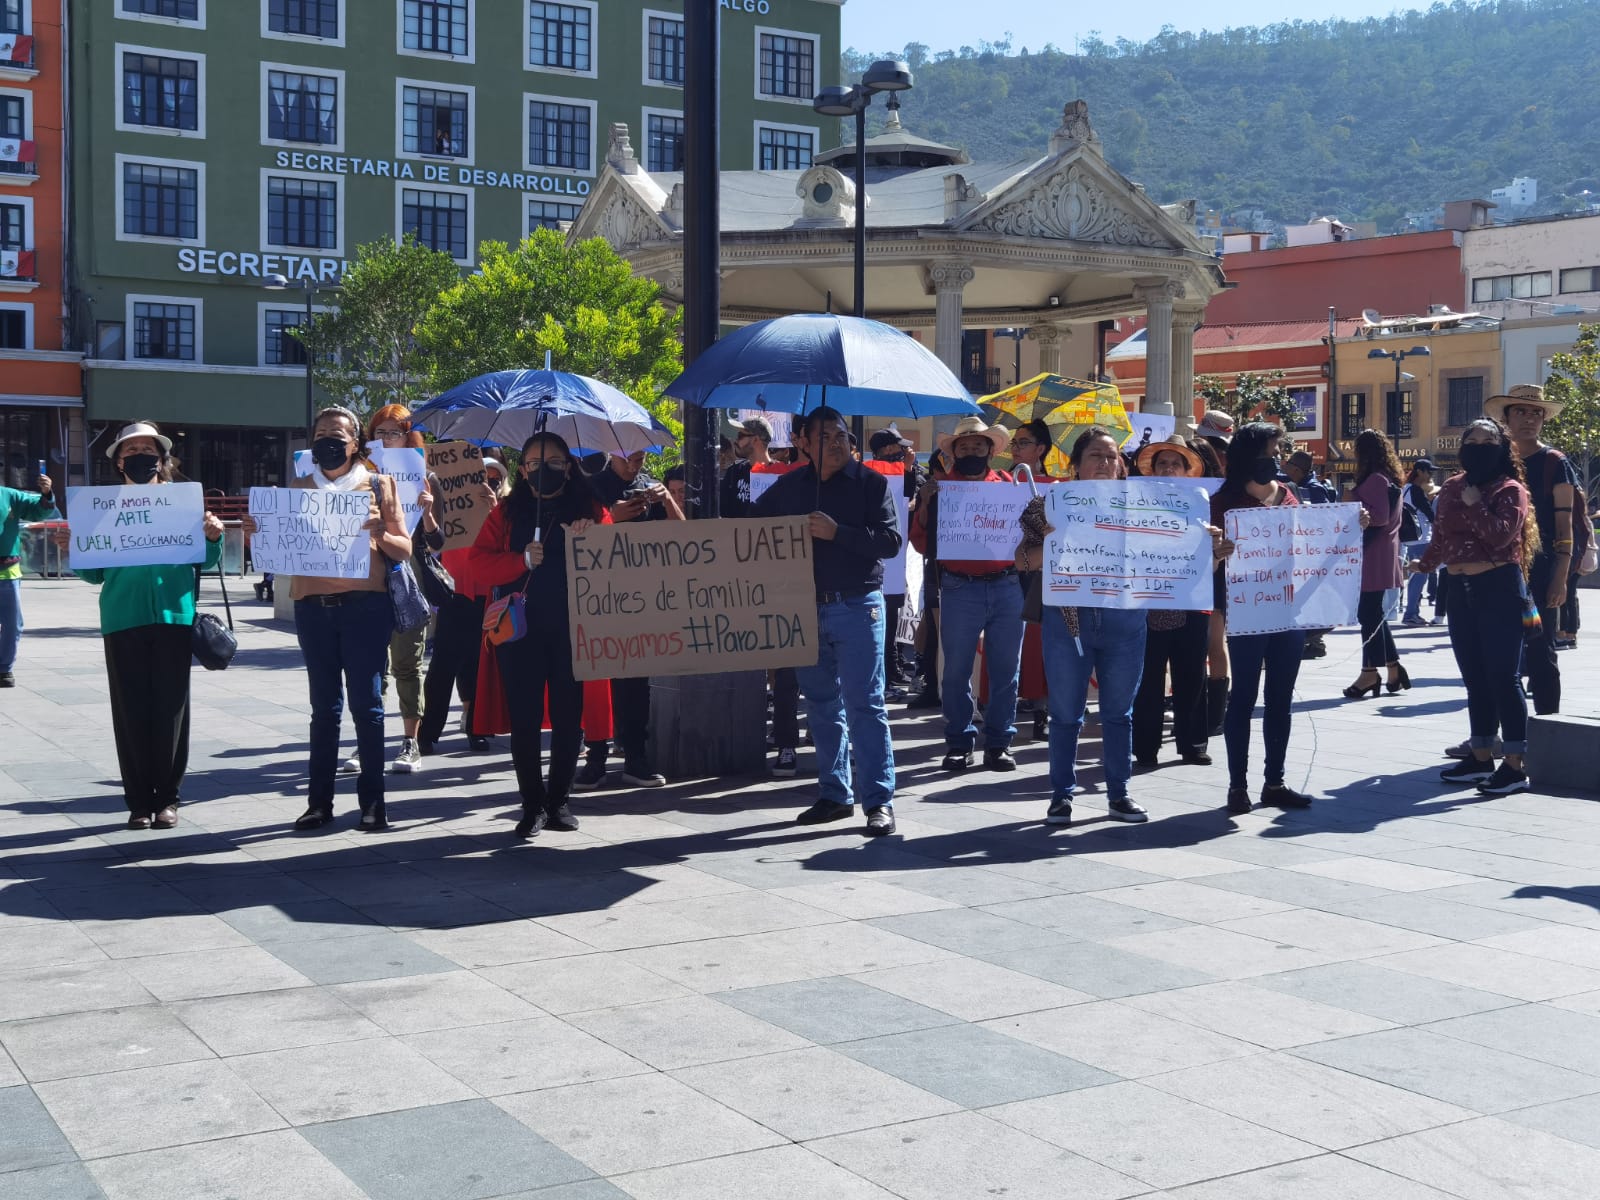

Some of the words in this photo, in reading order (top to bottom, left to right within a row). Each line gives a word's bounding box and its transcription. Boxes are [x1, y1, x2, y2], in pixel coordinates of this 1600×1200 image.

[276, 151, 414, 179] SECRETARIA
[424, 165, 450, 182] DE
[459, 168, 591, 196] DESARROLLO
[462, 444, 480, 460] de
[121, 497, 151, 509] AMOR
[155, 497, 171, 506] AL
[289, 489, 320, 515] LOS
[325, 491, 370, 516] PADRES
[1002, 503, 1017, 513] me
[115, 510, 152, 527] ARTE
[276, 516, 331, 533] FAMILIA
[339, 518, 362, 536] NO
[973, 513, 1007, 531] estudiar
[1066, 513, 1086, 523] no
[1334, 520, 1351, 534] de
[76, 535, 117, 552] UAEH,
[253, 535, 270, 549] LA
[277, 534, 347, 552] APOYAMOS
[572, 536, 603, 571] Ex
[608, 532, 717, 569] Alumnos
[734, 524, 807, 563] UAEH
[1287, 543, 1303, 556] de
[1306, 542, 1321, 555] los
[1231, 571, 1249, 584] del
[1254, 569, 1273, 583] IDA
[1293, 566, 1328, 581] apoyo
[1334, 567, 1353, 577] con
[1145, 579, 1175, 590] IDA
[575, 576, 646, 616] Padres
[655, 580, 677, 611] de
[686, 578, 765, 609] Familia
[575, 623, 684, 671] Apoyamos
[682, 613, 806, 654] #ParoIDA
